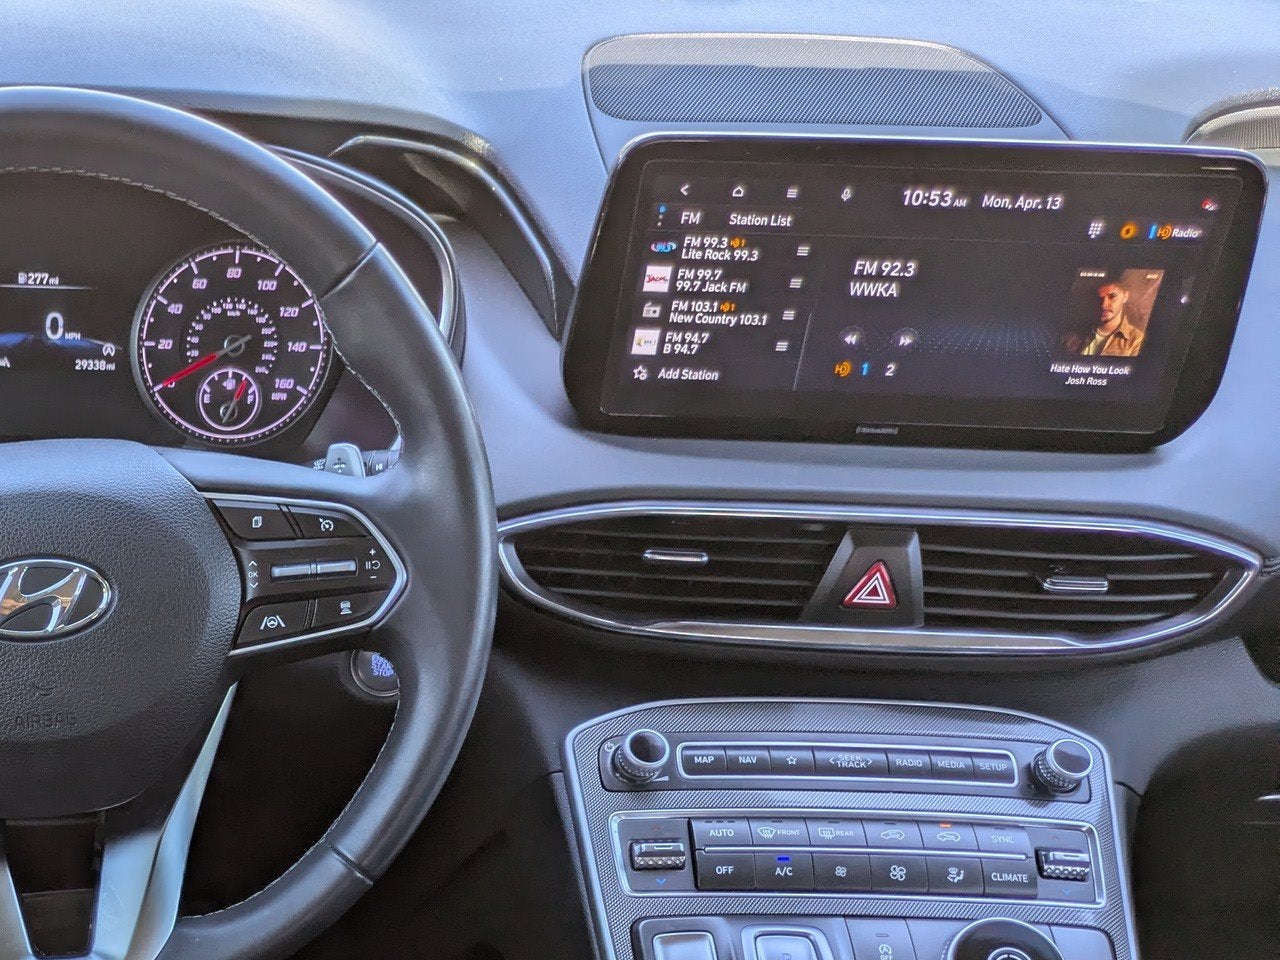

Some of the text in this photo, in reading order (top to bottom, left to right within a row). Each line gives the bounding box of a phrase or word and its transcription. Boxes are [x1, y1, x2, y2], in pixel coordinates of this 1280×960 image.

[903, 190, 967, 207] 10:53 AM
[982, 195, 1062, 211] Mon, Apr. 13
[681, 212, 701, 224] FM
[729, 214, 791, 226] Station List
[683, 237, 701, 248] FM
[703, 237, 728, 249] 99.3
[681, 248, 758, 261] Lite Rock 99.3
[226, 267, 242, 278] 80
[853, 261, 915, 277] FM 92.3
[677, 269, 722, 281] FM 99.7
[192, 278, 207, 289] 60
[257, 279, 277, 291] 100
[675, 281, 747, 293] 99.7 Jack FM
[850, 282, 897, 297] WWKA
[167, 303, 183, 314] 40
[279, 306, 299, 318] 120
[671, 300, 689, 311] FM
[690, 301, 718, 313] 103.1
[669, 312, 768, 327] New Country 103.1
[46, 311, 64, 340] 0
[665, 332, 683, 343] FM
[684, 332, 710, 344] 94.7
[157, 339, 173, 350] 20
[287, 341, 307, 352] 140
[663, 343, 699, 355] B 94.7
[657, 367, 719, 380] Add Station
[862, 362, 869, 376] 1
[885, 363, 896, 377] 2
[1050, 364, 1130, 375] Hate How You Look
[274, 378, 294, 389] 160
[1065, 376, 1108, 386] Josh Ross
[694, 755, 715, 764] MAP
[738, 755, 757, 764] NAV
[838, 753, 863, 762] SEEK
[836, 760, 867, 769] TRACK
[896, 759, 923, 768] RADIO
[937, 760, 965, 770] MEDIA
[979, 762, 1008, 772] SETUP
[709, 828, 734, 837] AUTO
[777, 828, 800, 837] FRONT
[991, 835, 1015, 844] SYNC
[715, 865, 734, 875] OFF
[775, 866, 793, 876] A/C
[991, 872, 1029, 883] CLIMATE
